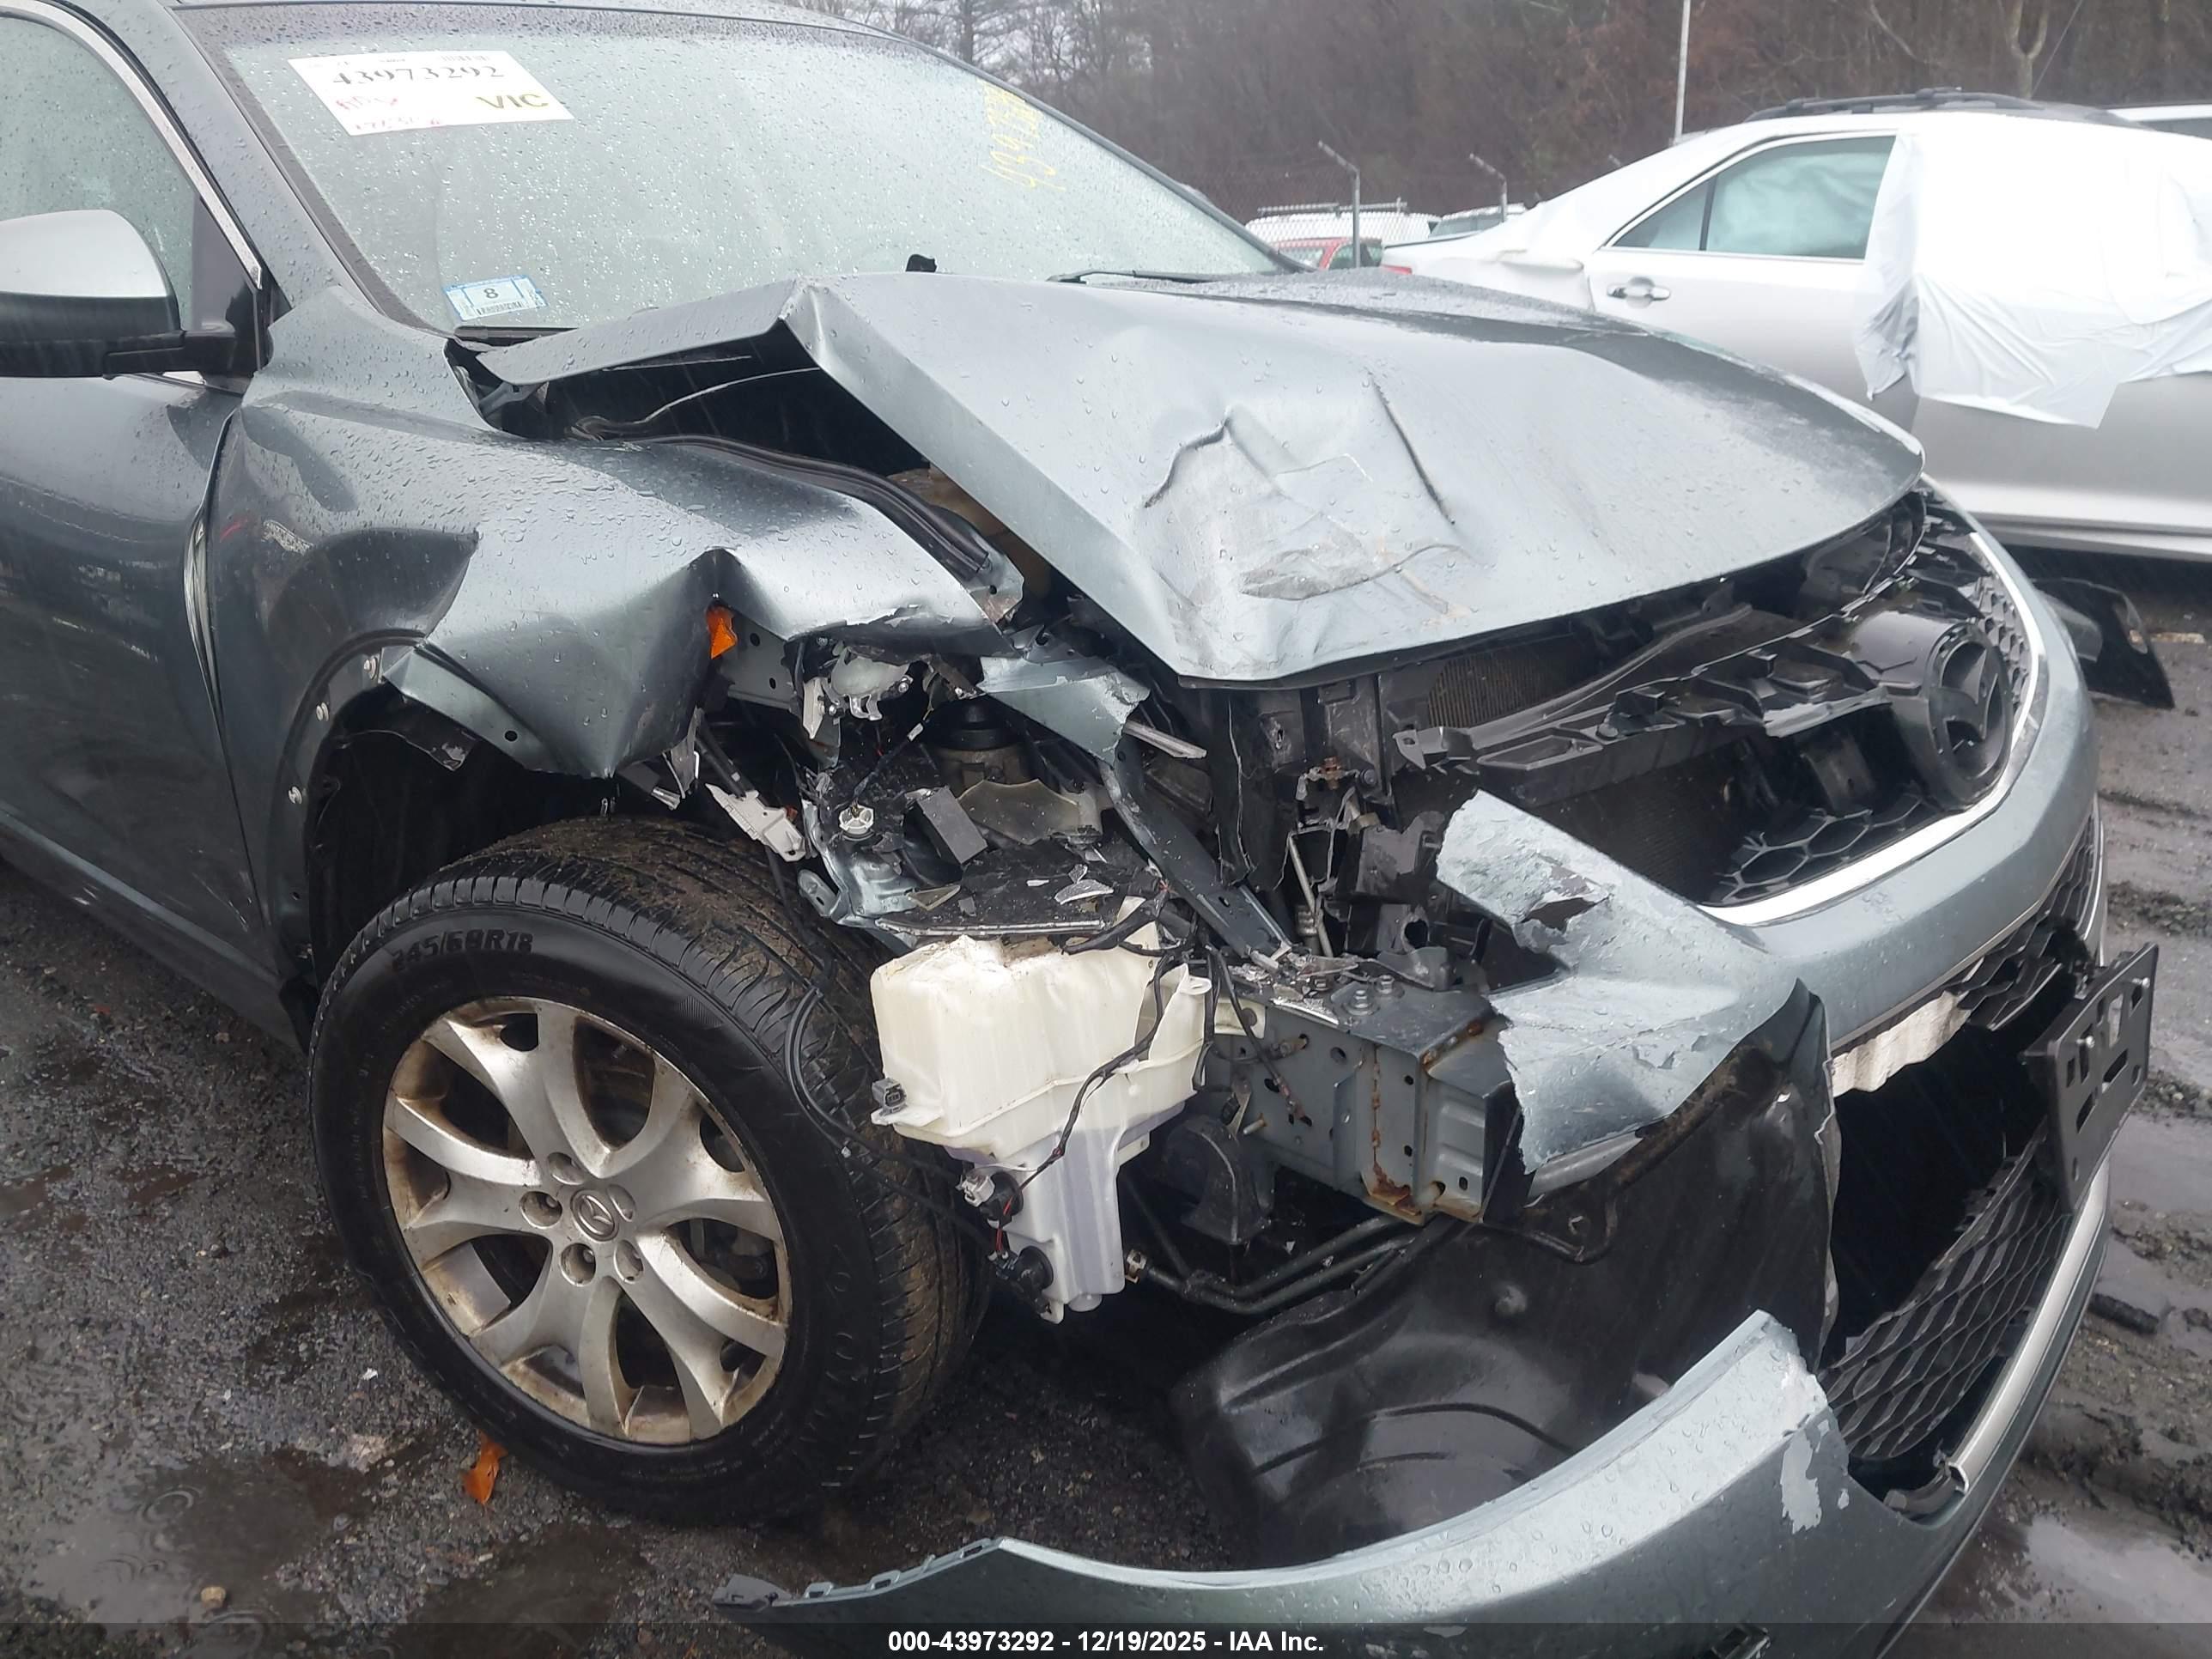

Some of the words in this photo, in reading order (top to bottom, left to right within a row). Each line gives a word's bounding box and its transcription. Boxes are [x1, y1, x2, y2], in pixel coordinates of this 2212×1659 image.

[332, 64, 505, 85] 43973292
[476, 93, 549, 111] VIC
[483, 288, 499, 300] 8
